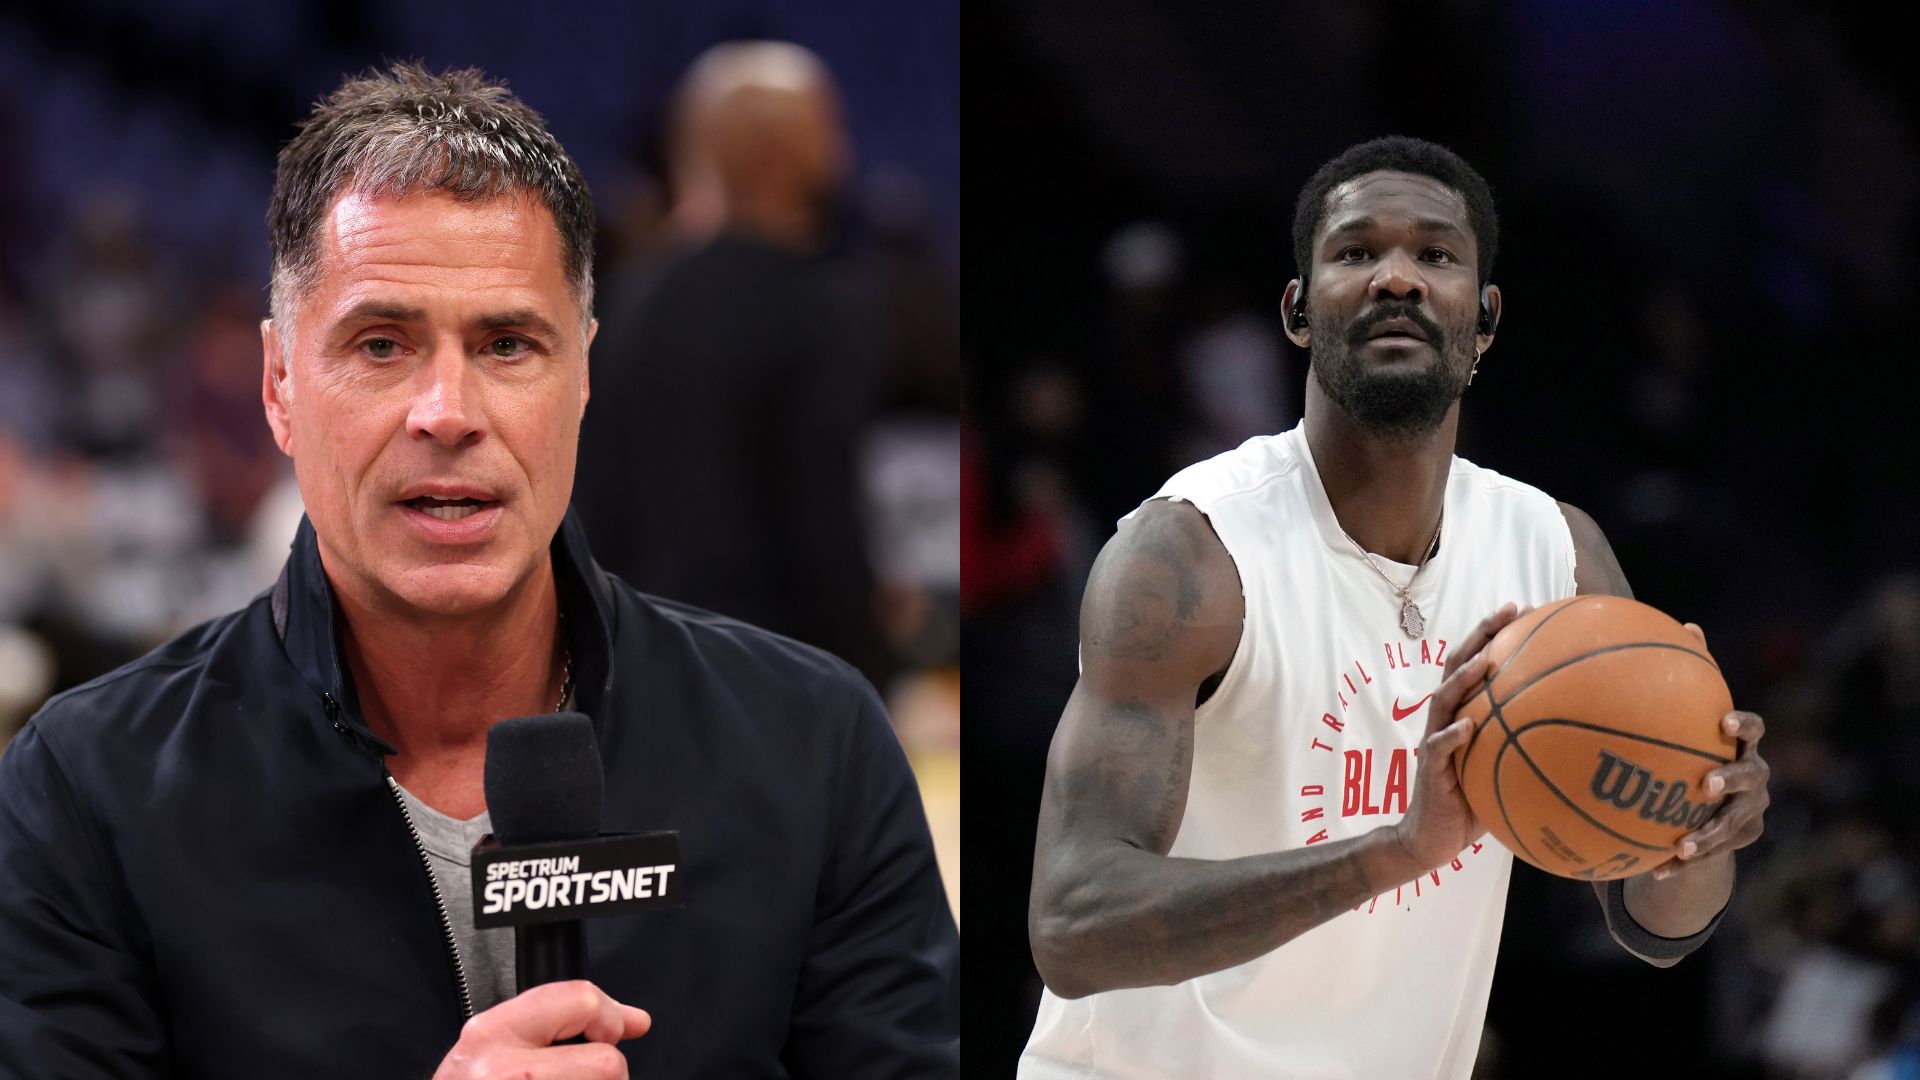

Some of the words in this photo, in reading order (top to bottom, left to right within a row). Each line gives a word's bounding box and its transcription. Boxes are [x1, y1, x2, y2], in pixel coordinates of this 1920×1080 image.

[1311, 660, 1372, 752] TRAIL
[1342, 748, 1419, 818] BLA
[482, 864, 676, 914] SPORTSNET
[486, 855, 580, 882] SPECTRUM
